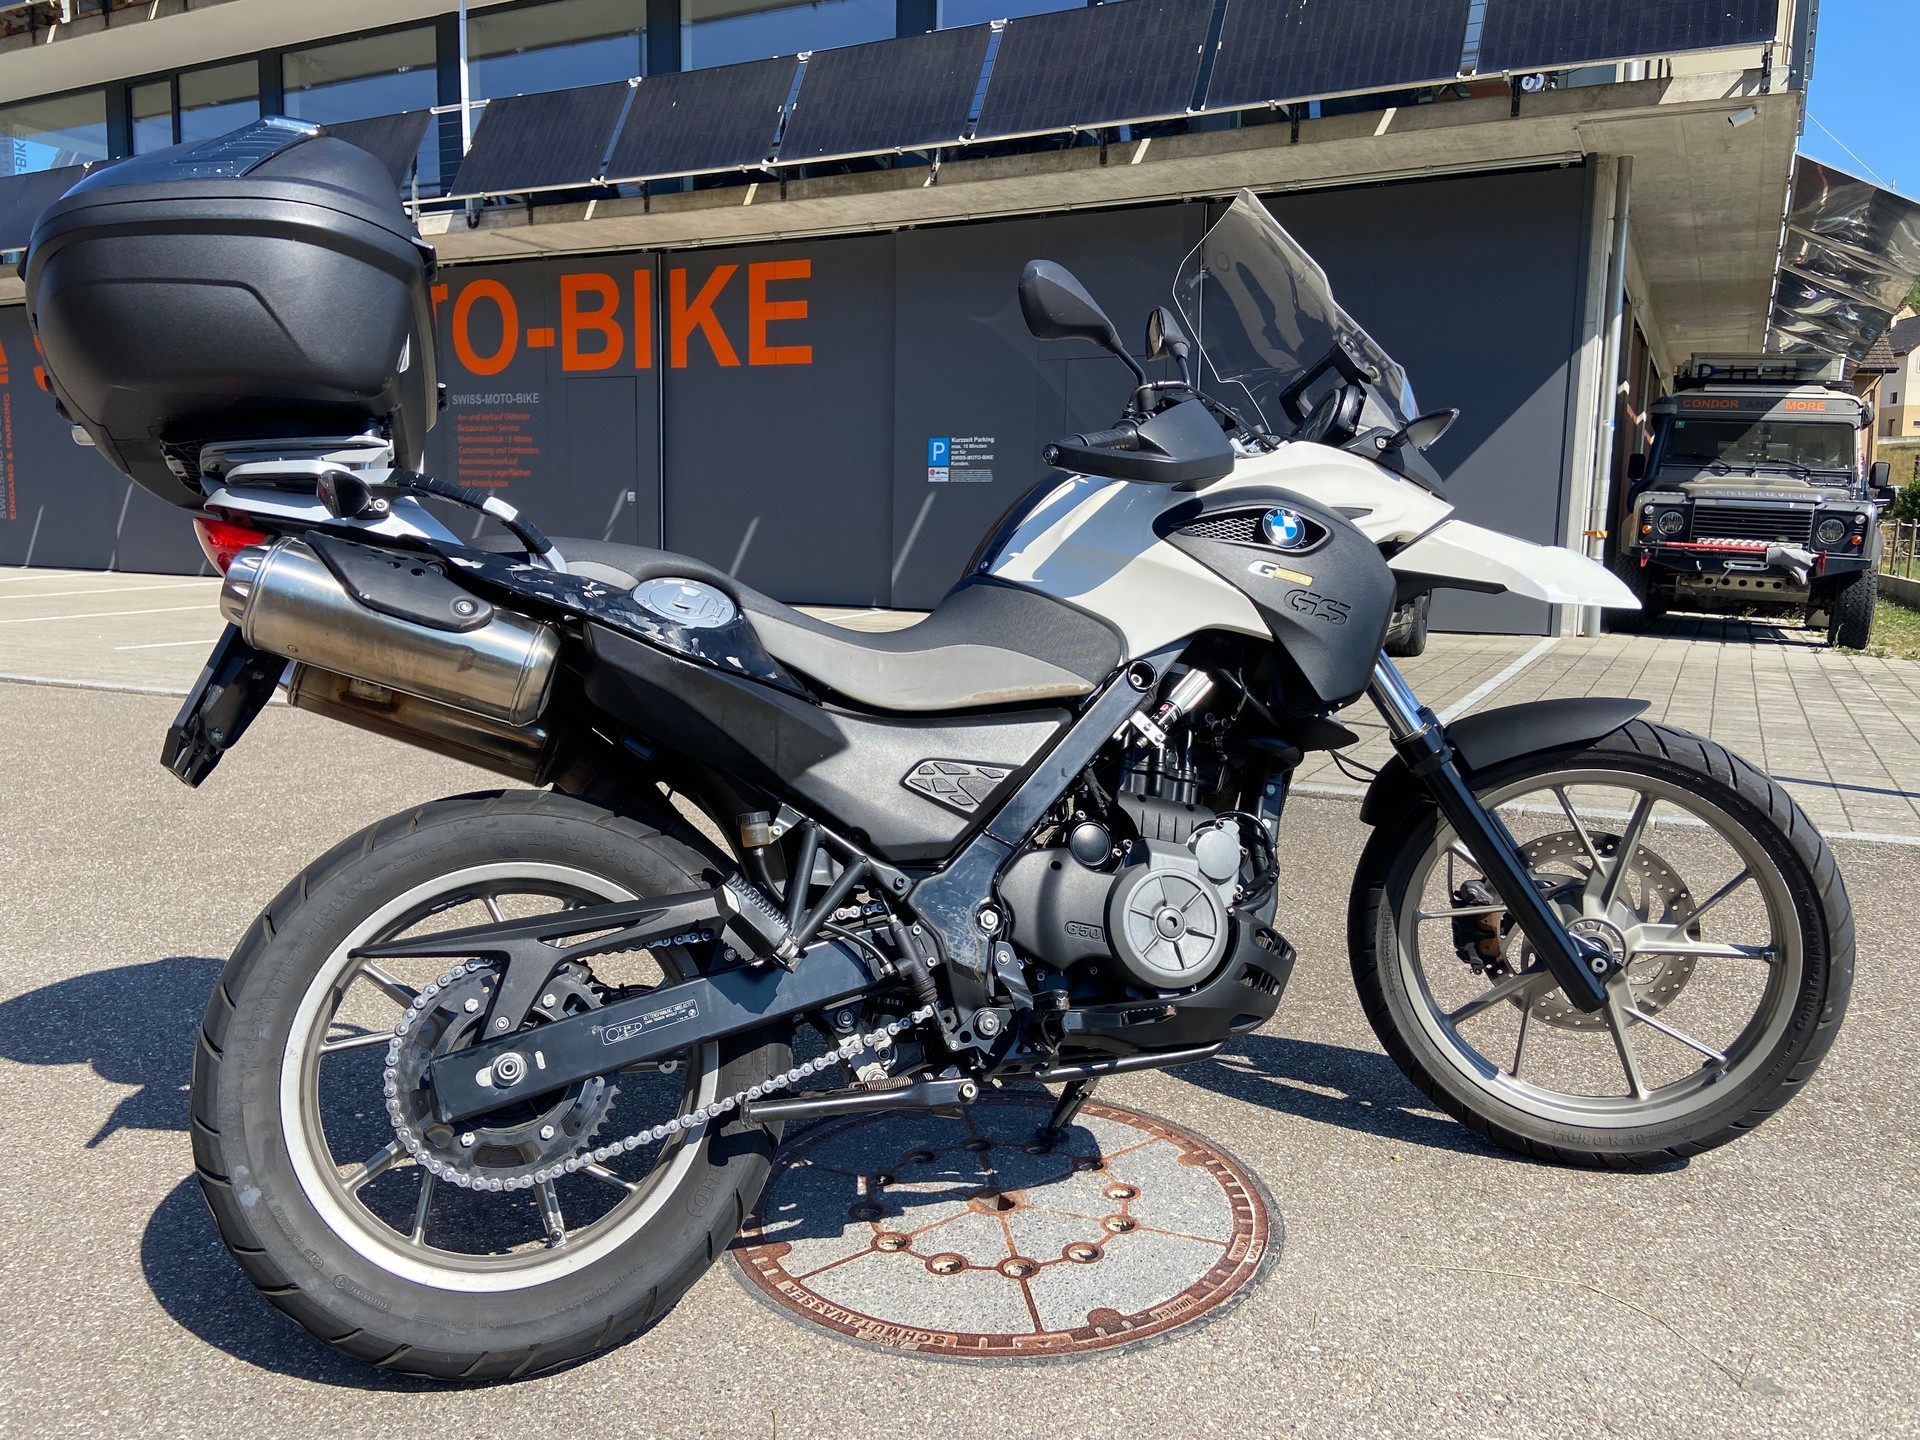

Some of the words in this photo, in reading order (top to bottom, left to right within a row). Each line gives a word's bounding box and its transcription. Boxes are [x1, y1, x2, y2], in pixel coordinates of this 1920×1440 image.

[452, 393, 540, 405] SWISS-MOTO-BIKE
[1682, 400, 1740, 408] CONDOR
[3, 392, 13, 449] PARKING
[468, 412, 480, 420] und
[482, 412, 503, 421] Verkauf
[504, 412, 530, 420] Oldtimer
[458, 424, 494, 432] Restauration
[499, 424, 520, 432] Service
[6, 452, 14, 461] &
[932, 442, 946, 462] P
[7, 463, 17, 520] EINGANG
[1284, 588, 1352, 626] GS
[304, 1250, 324, 1269] 4422
[784, 1284, 947, 1345] SCHMUTZWASSER
